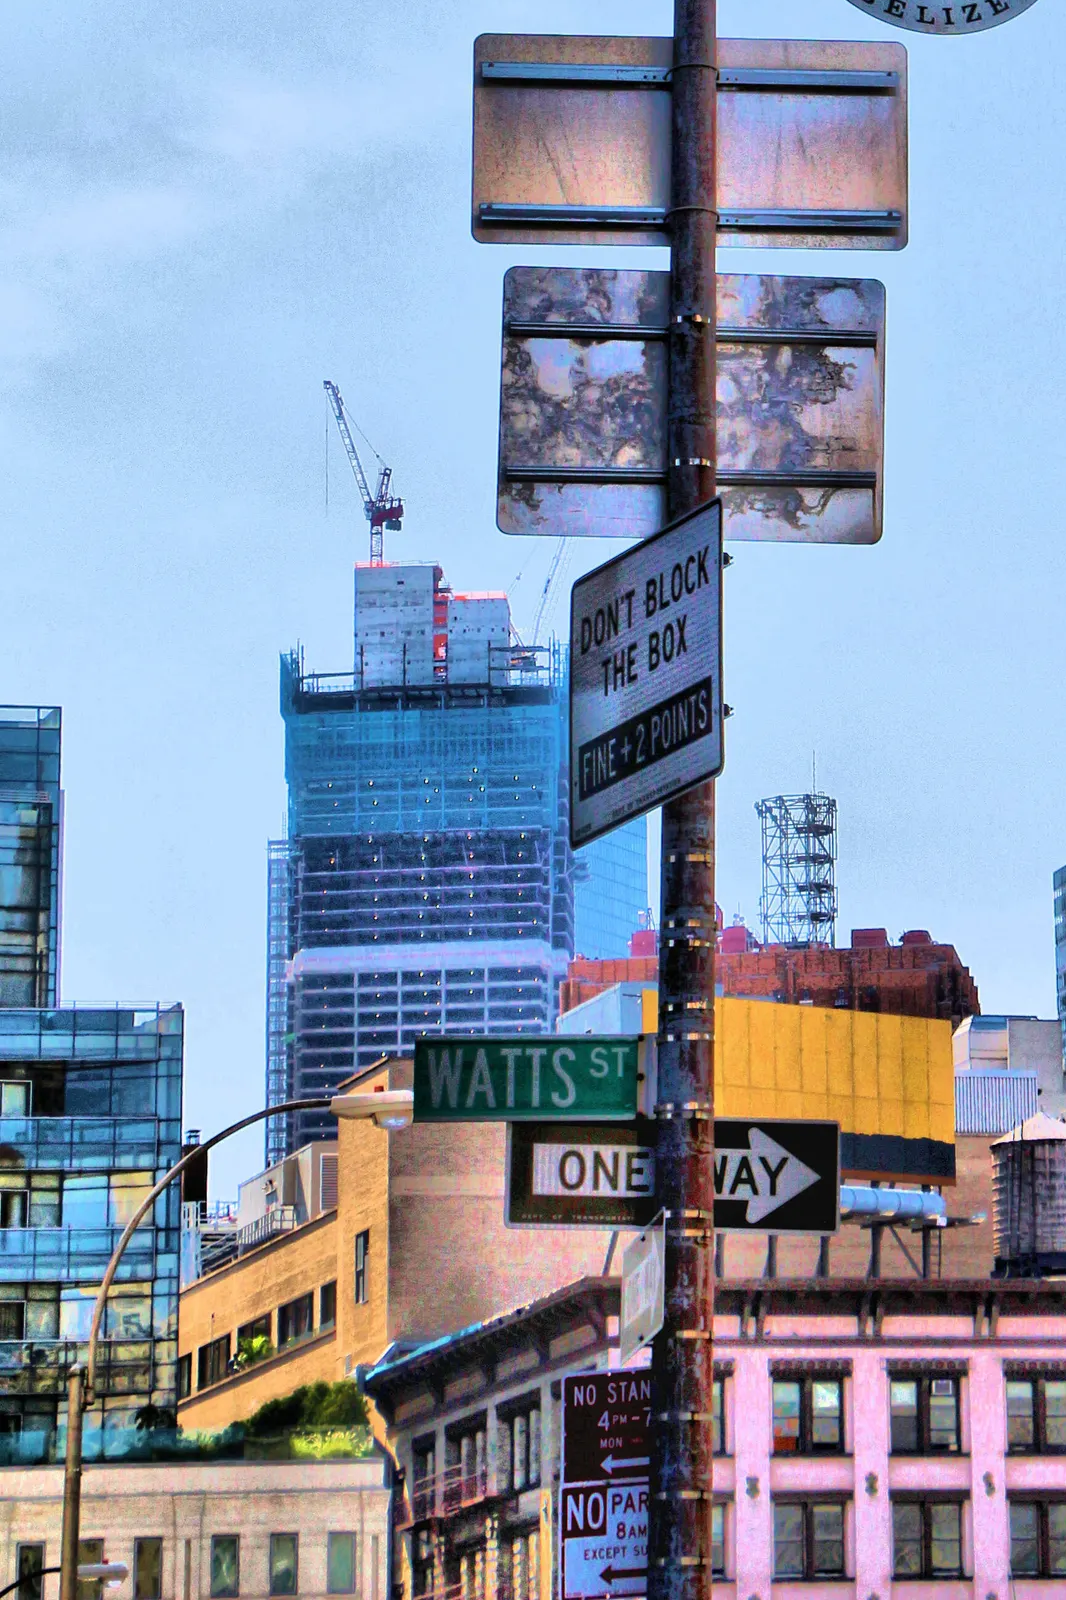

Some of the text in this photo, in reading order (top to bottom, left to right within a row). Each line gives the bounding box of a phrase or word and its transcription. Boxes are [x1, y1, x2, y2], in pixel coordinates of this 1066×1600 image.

[580, 546, 710, 656] DON'T BLOCK
[601, 614, 687, 697] THE BOX
[583, 738, 617, 791] FINE
[635, 723, 646, 765] 2
[651, 687, 708, 756] POINTS
[427, 1046, 630, 1109] WATTS ST
[558, 1149, 789, 1196] ONE AY
[573, 1384, 597, 1406] NO
[600, 1437, 623, 1449] MON
[566, 1492, 605, 1531] NO
[584, 1546, 627, 1561] EXCEPT
